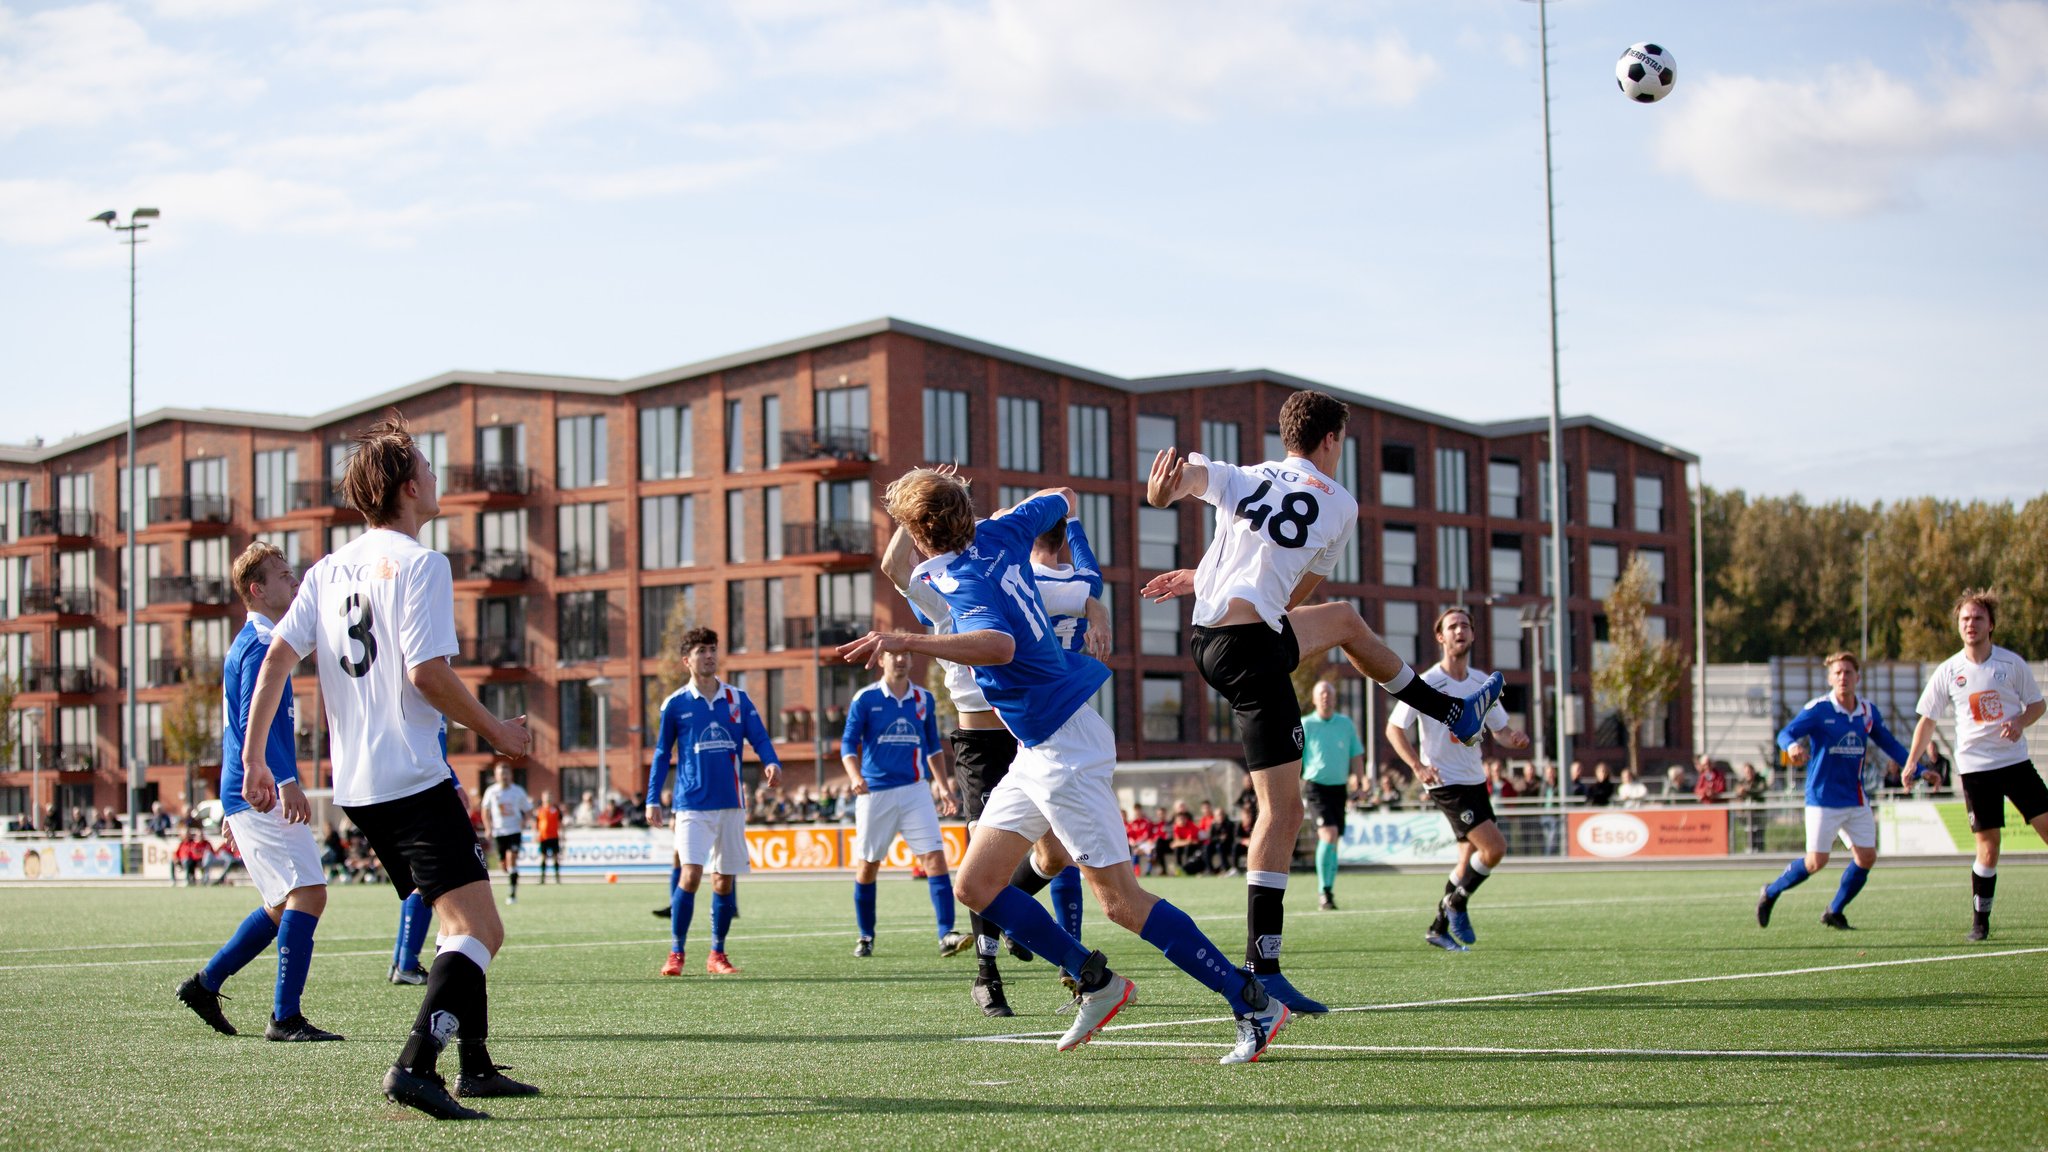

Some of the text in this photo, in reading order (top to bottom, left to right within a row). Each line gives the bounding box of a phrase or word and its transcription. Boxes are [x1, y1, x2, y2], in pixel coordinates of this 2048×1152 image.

[1254, 467, 1299, 483] NG
[1233, 480, 1319, 548] 48
[330, 563, 371, 584] ING
[1001, 564, 1048, 642] 11
[340, 593, 377, 678] 3
[745, 836, 789, 868] NG
[848, 833, 913, 867] IG
[1592, 827, 1639, 844] Esso
